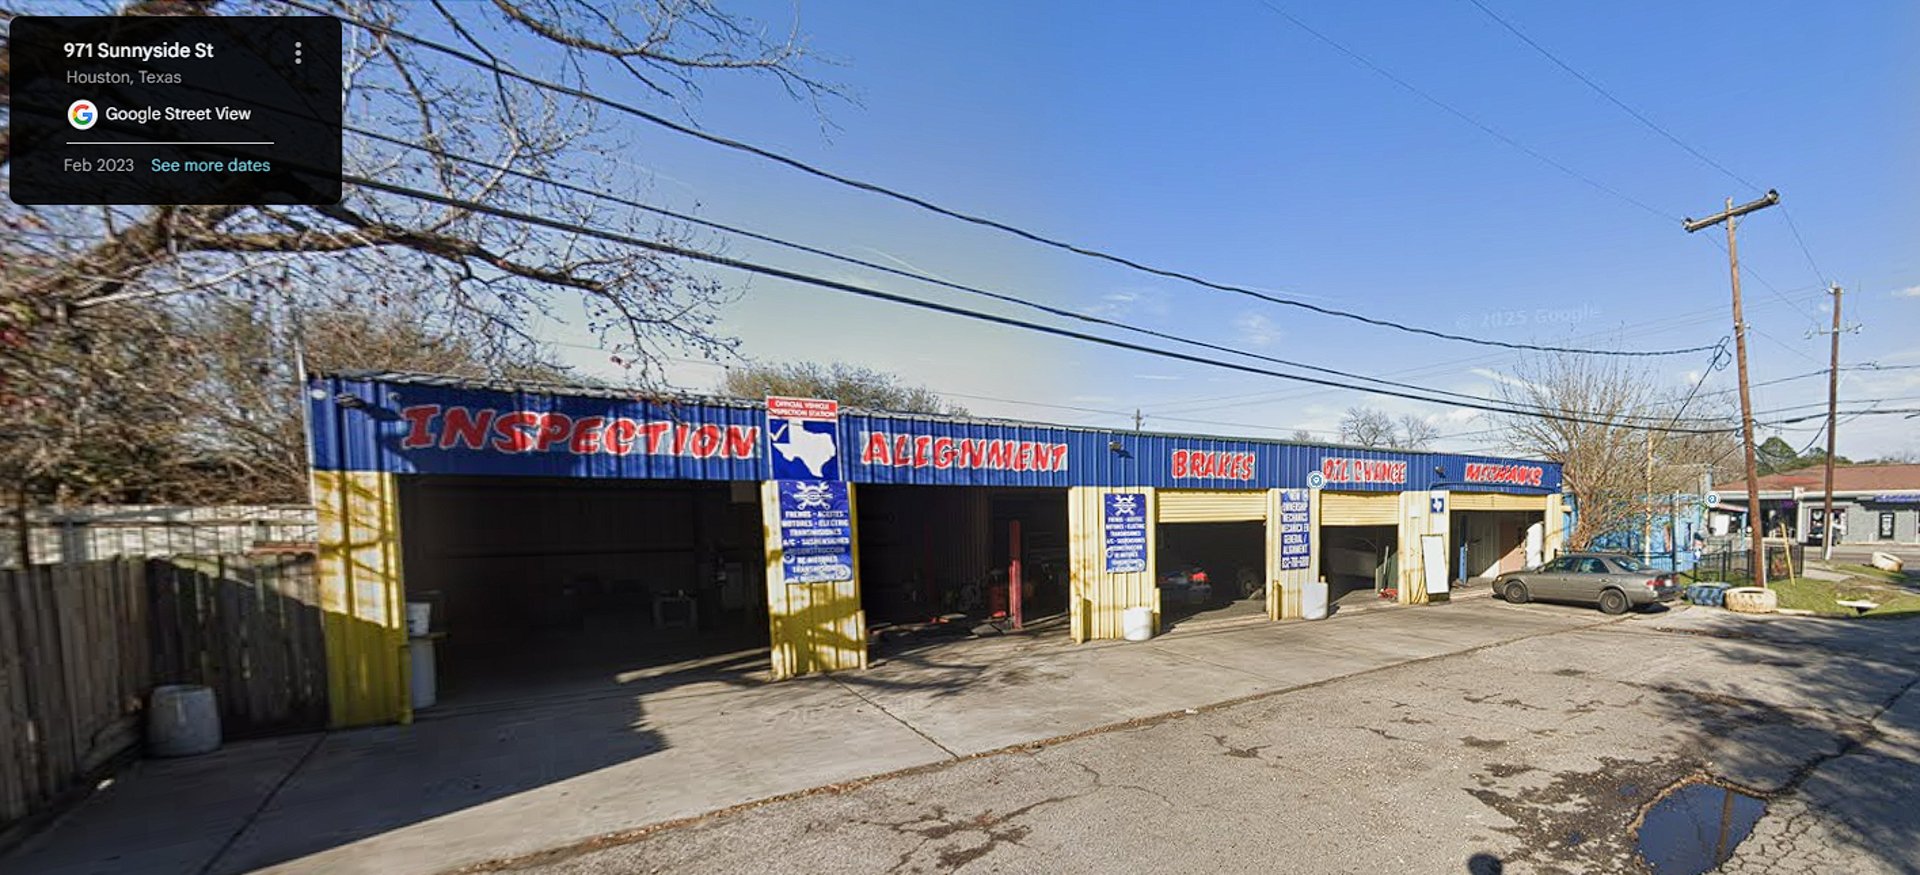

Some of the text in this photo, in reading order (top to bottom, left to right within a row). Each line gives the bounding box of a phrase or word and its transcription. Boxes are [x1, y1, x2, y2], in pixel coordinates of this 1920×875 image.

[775, 400, 829, 410] OFFICIAL VEHICLE
[401, 404, 760, 460] INSPECTION
[861, 432, 1068, 472] ALIGNMENT
[1172, 449, 1255, 481] BRAKES
[1323, 458, 1406, 484] OIL CHANGE
[1466, 463, 1543, 487] MCHANS
